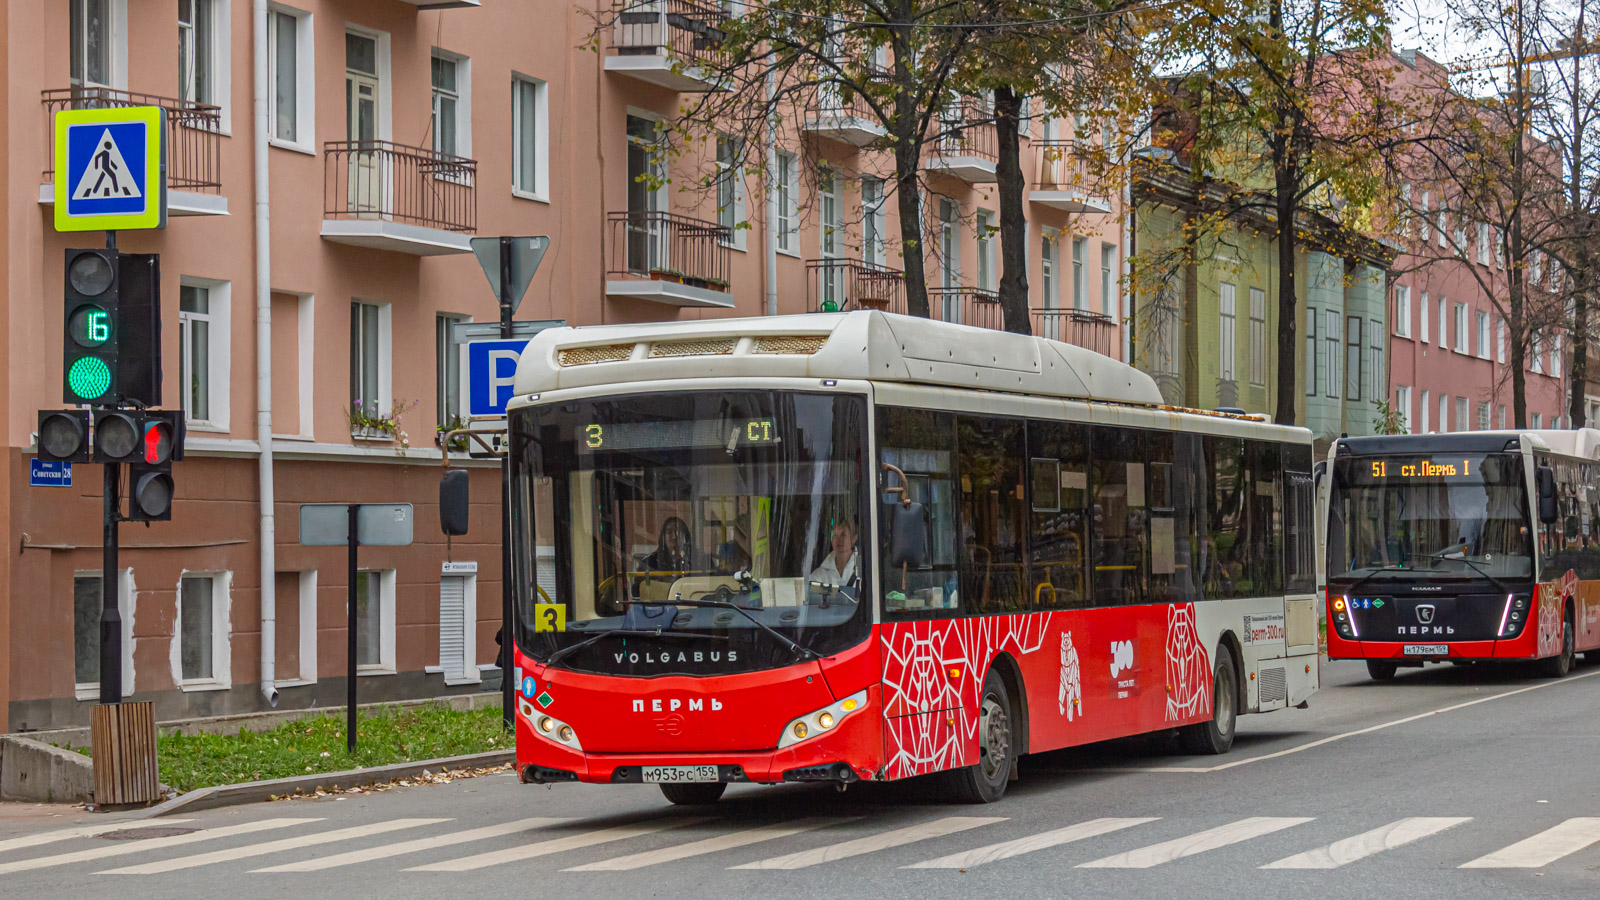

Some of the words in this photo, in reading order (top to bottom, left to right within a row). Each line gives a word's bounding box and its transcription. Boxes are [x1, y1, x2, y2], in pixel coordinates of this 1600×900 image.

[88, 312, 108, 341] 16
[488, 350, 521, 407] P
[585, 424, 603, 448] 3
[747, 421, 771, 441] СТ
[32, 468, 62, 478] Советская
[63, 468, 72, 478] 28
[1372, 461, 1386, 477] 51
[1401, 460, 1457, 477] ст.Пермь
[543, 607, 559, 633] 3
[1251, 625, 1285, 645] perm-300.ru
[1397, 626, 1455, 635] ПЕРМЬ
[614, 651, 738, 664] VOLGABUS
[632, 698, 723, 712] ПЕРМЬ
[646, 768, 694, 781] М953РС
[696, 766, 715, 777] 159
